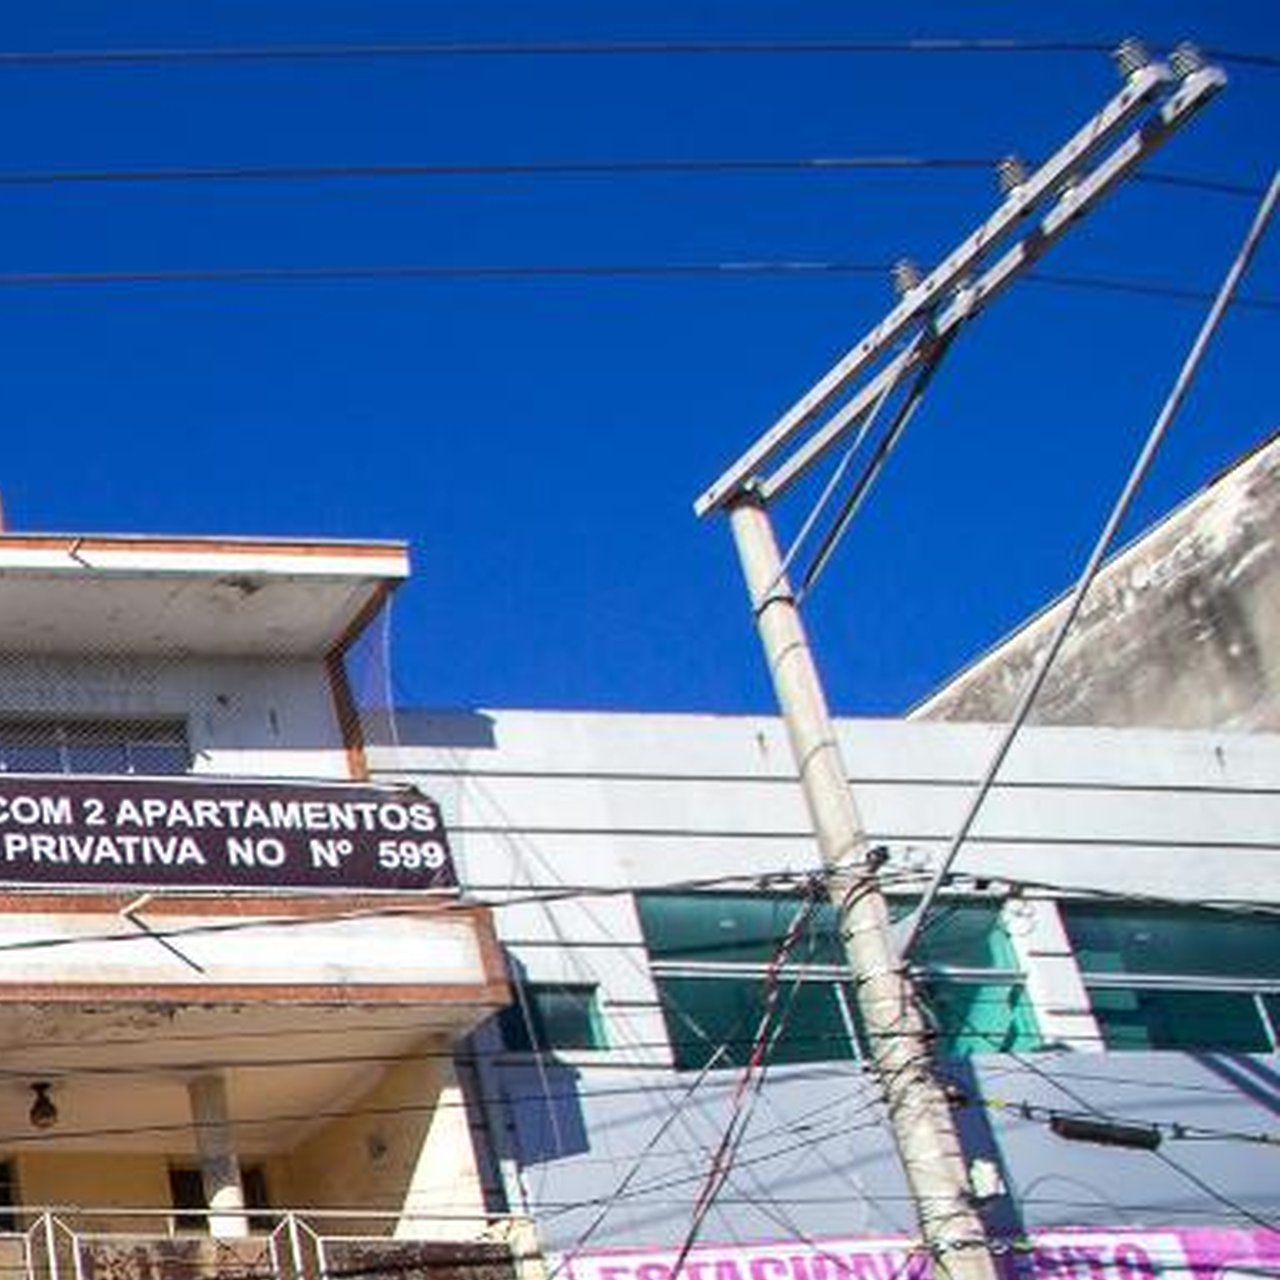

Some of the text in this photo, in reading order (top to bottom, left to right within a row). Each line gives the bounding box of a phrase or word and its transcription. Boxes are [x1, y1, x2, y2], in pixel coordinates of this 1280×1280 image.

[83, 799, 108, 828] 2
[115, 799, 438, 833] APARTAMENTOS
[4, 834, 207, 867] PRIVATIVA
[227, 837, 287, 868] NO
[378, 838, 446, 870] 599
